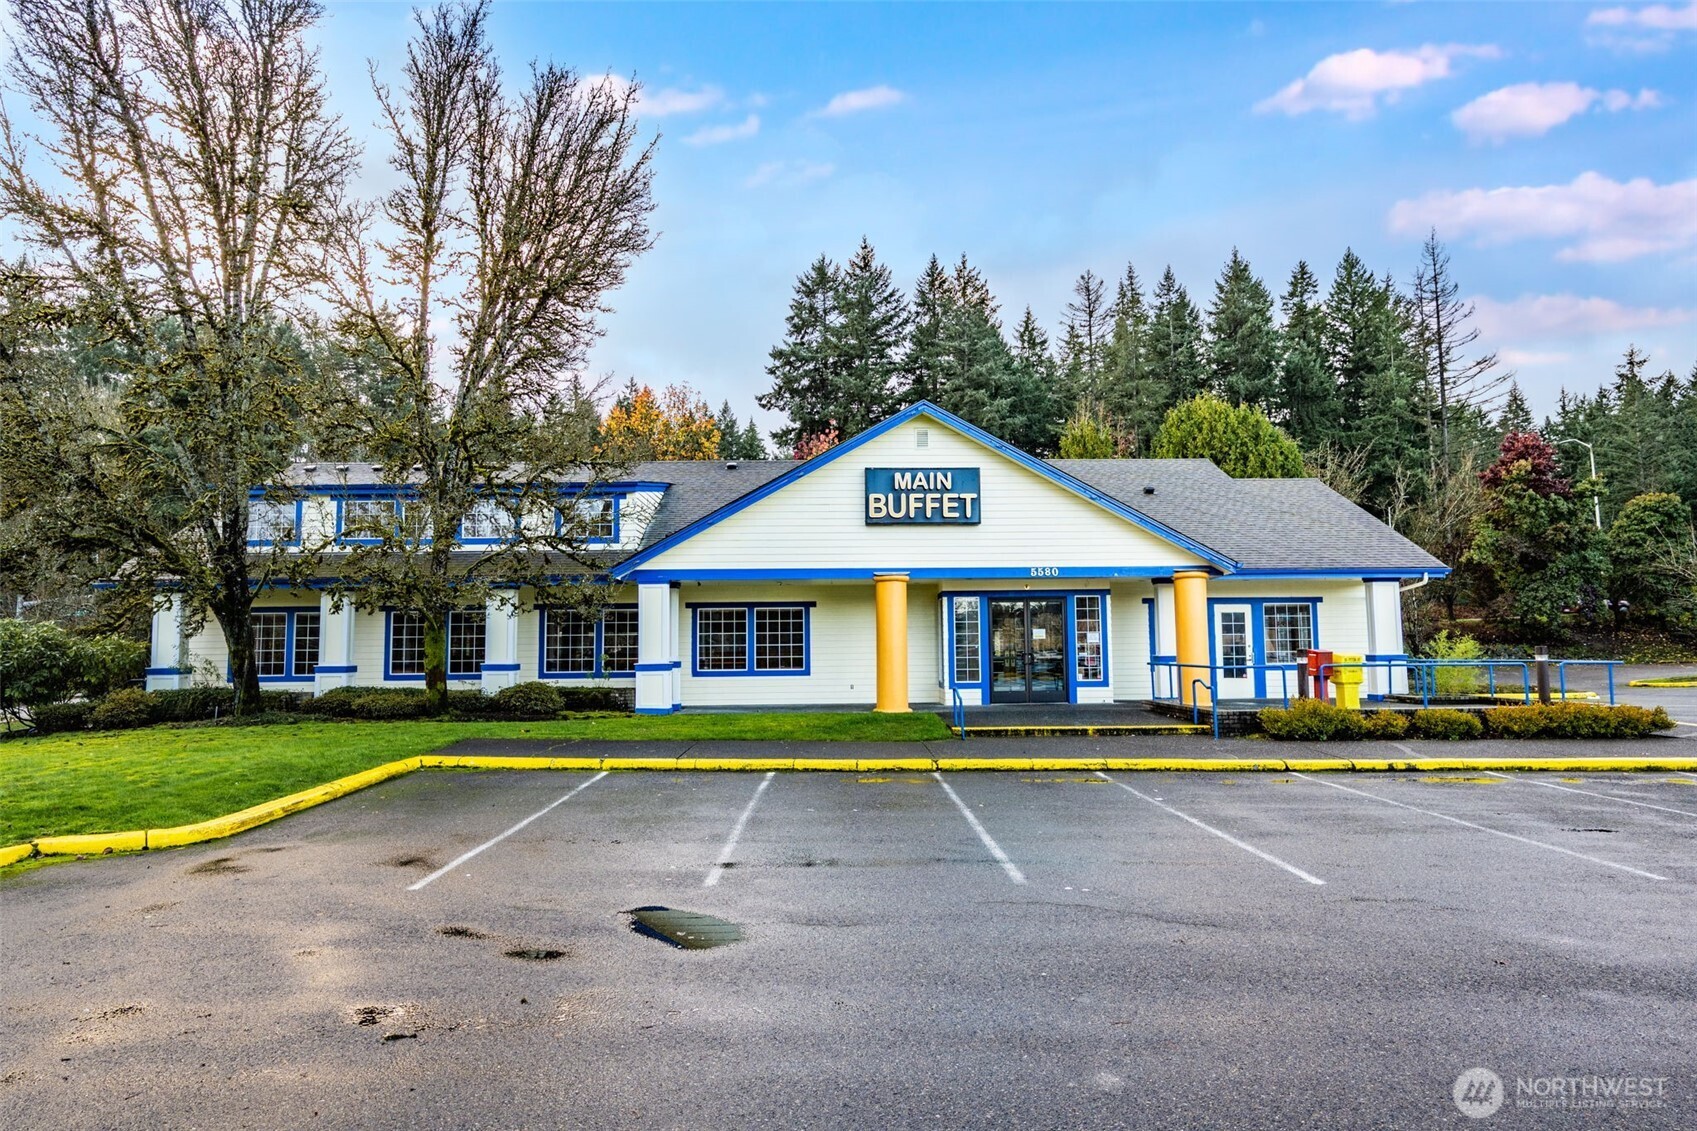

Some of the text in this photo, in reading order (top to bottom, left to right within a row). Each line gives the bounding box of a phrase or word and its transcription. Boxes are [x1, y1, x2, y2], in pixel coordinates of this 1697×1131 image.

[894, 471, 952, 490] MAIN
[868, 493, 978, 518] BUFFET
[1030, 567, 1059, 577] 5580
